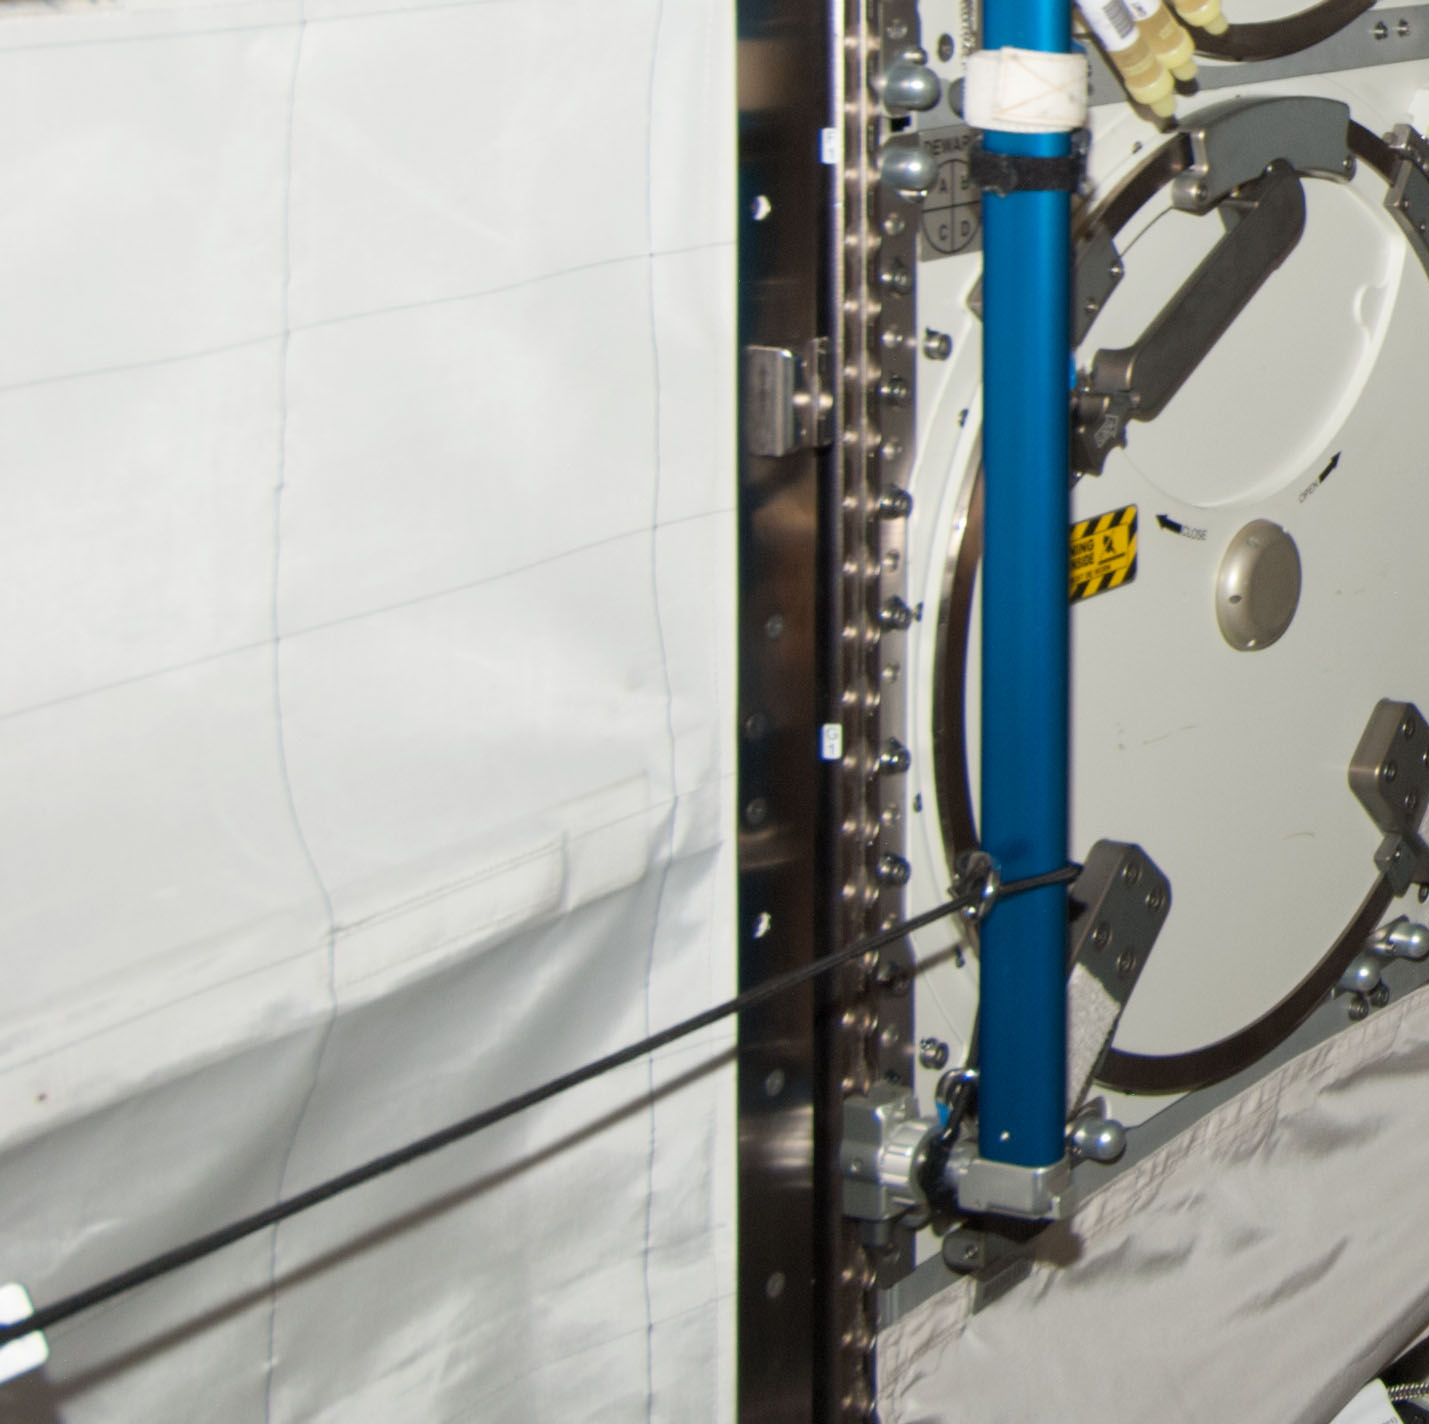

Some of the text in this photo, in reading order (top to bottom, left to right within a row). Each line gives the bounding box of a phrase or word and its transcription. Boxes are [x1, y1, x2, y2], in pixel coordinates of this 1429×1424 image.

[939, 179, 948, 193] A
[939, 219, 970, 242] C D
[1297, 481, 1320, 504] OPEN
[1181, 525, 1207, 541] CLOSE
[1070, 539, 1095, 555] NING
[1070, 552, 1095, 569] NSIDE
